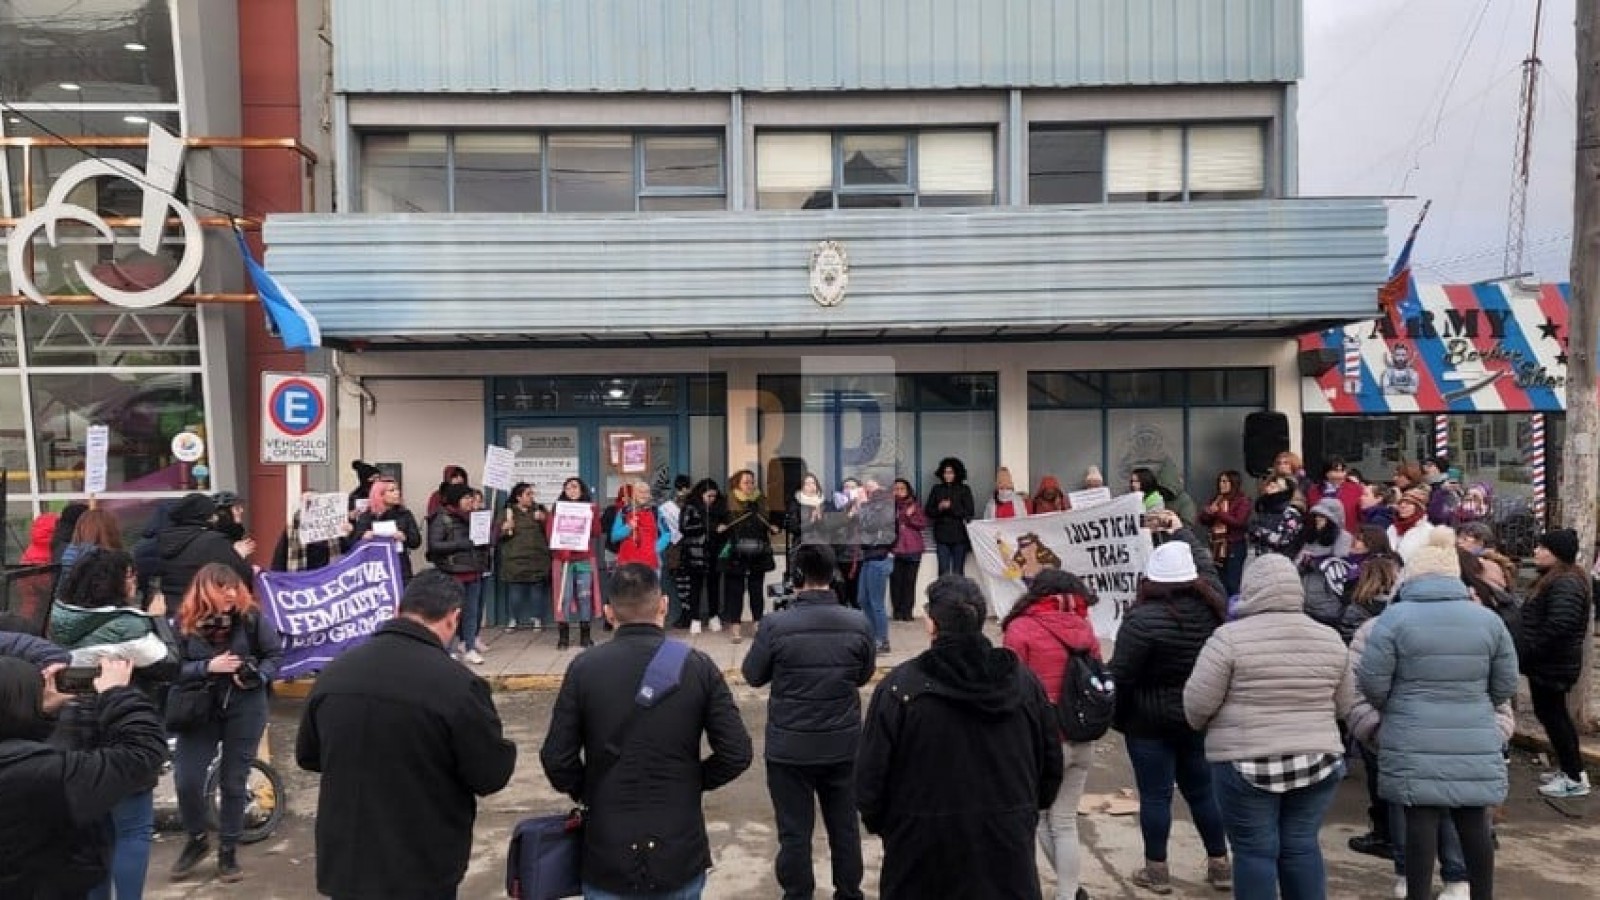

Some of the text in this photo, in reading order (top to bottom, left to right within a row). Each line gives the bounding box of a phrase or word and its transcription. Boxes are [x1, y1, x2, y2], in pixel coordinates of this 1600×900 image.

[1368, 308, 1513, 340] ARMY
[284, 391, 310, 424] E
[276, 560, 390, 610] COLECTIVA
